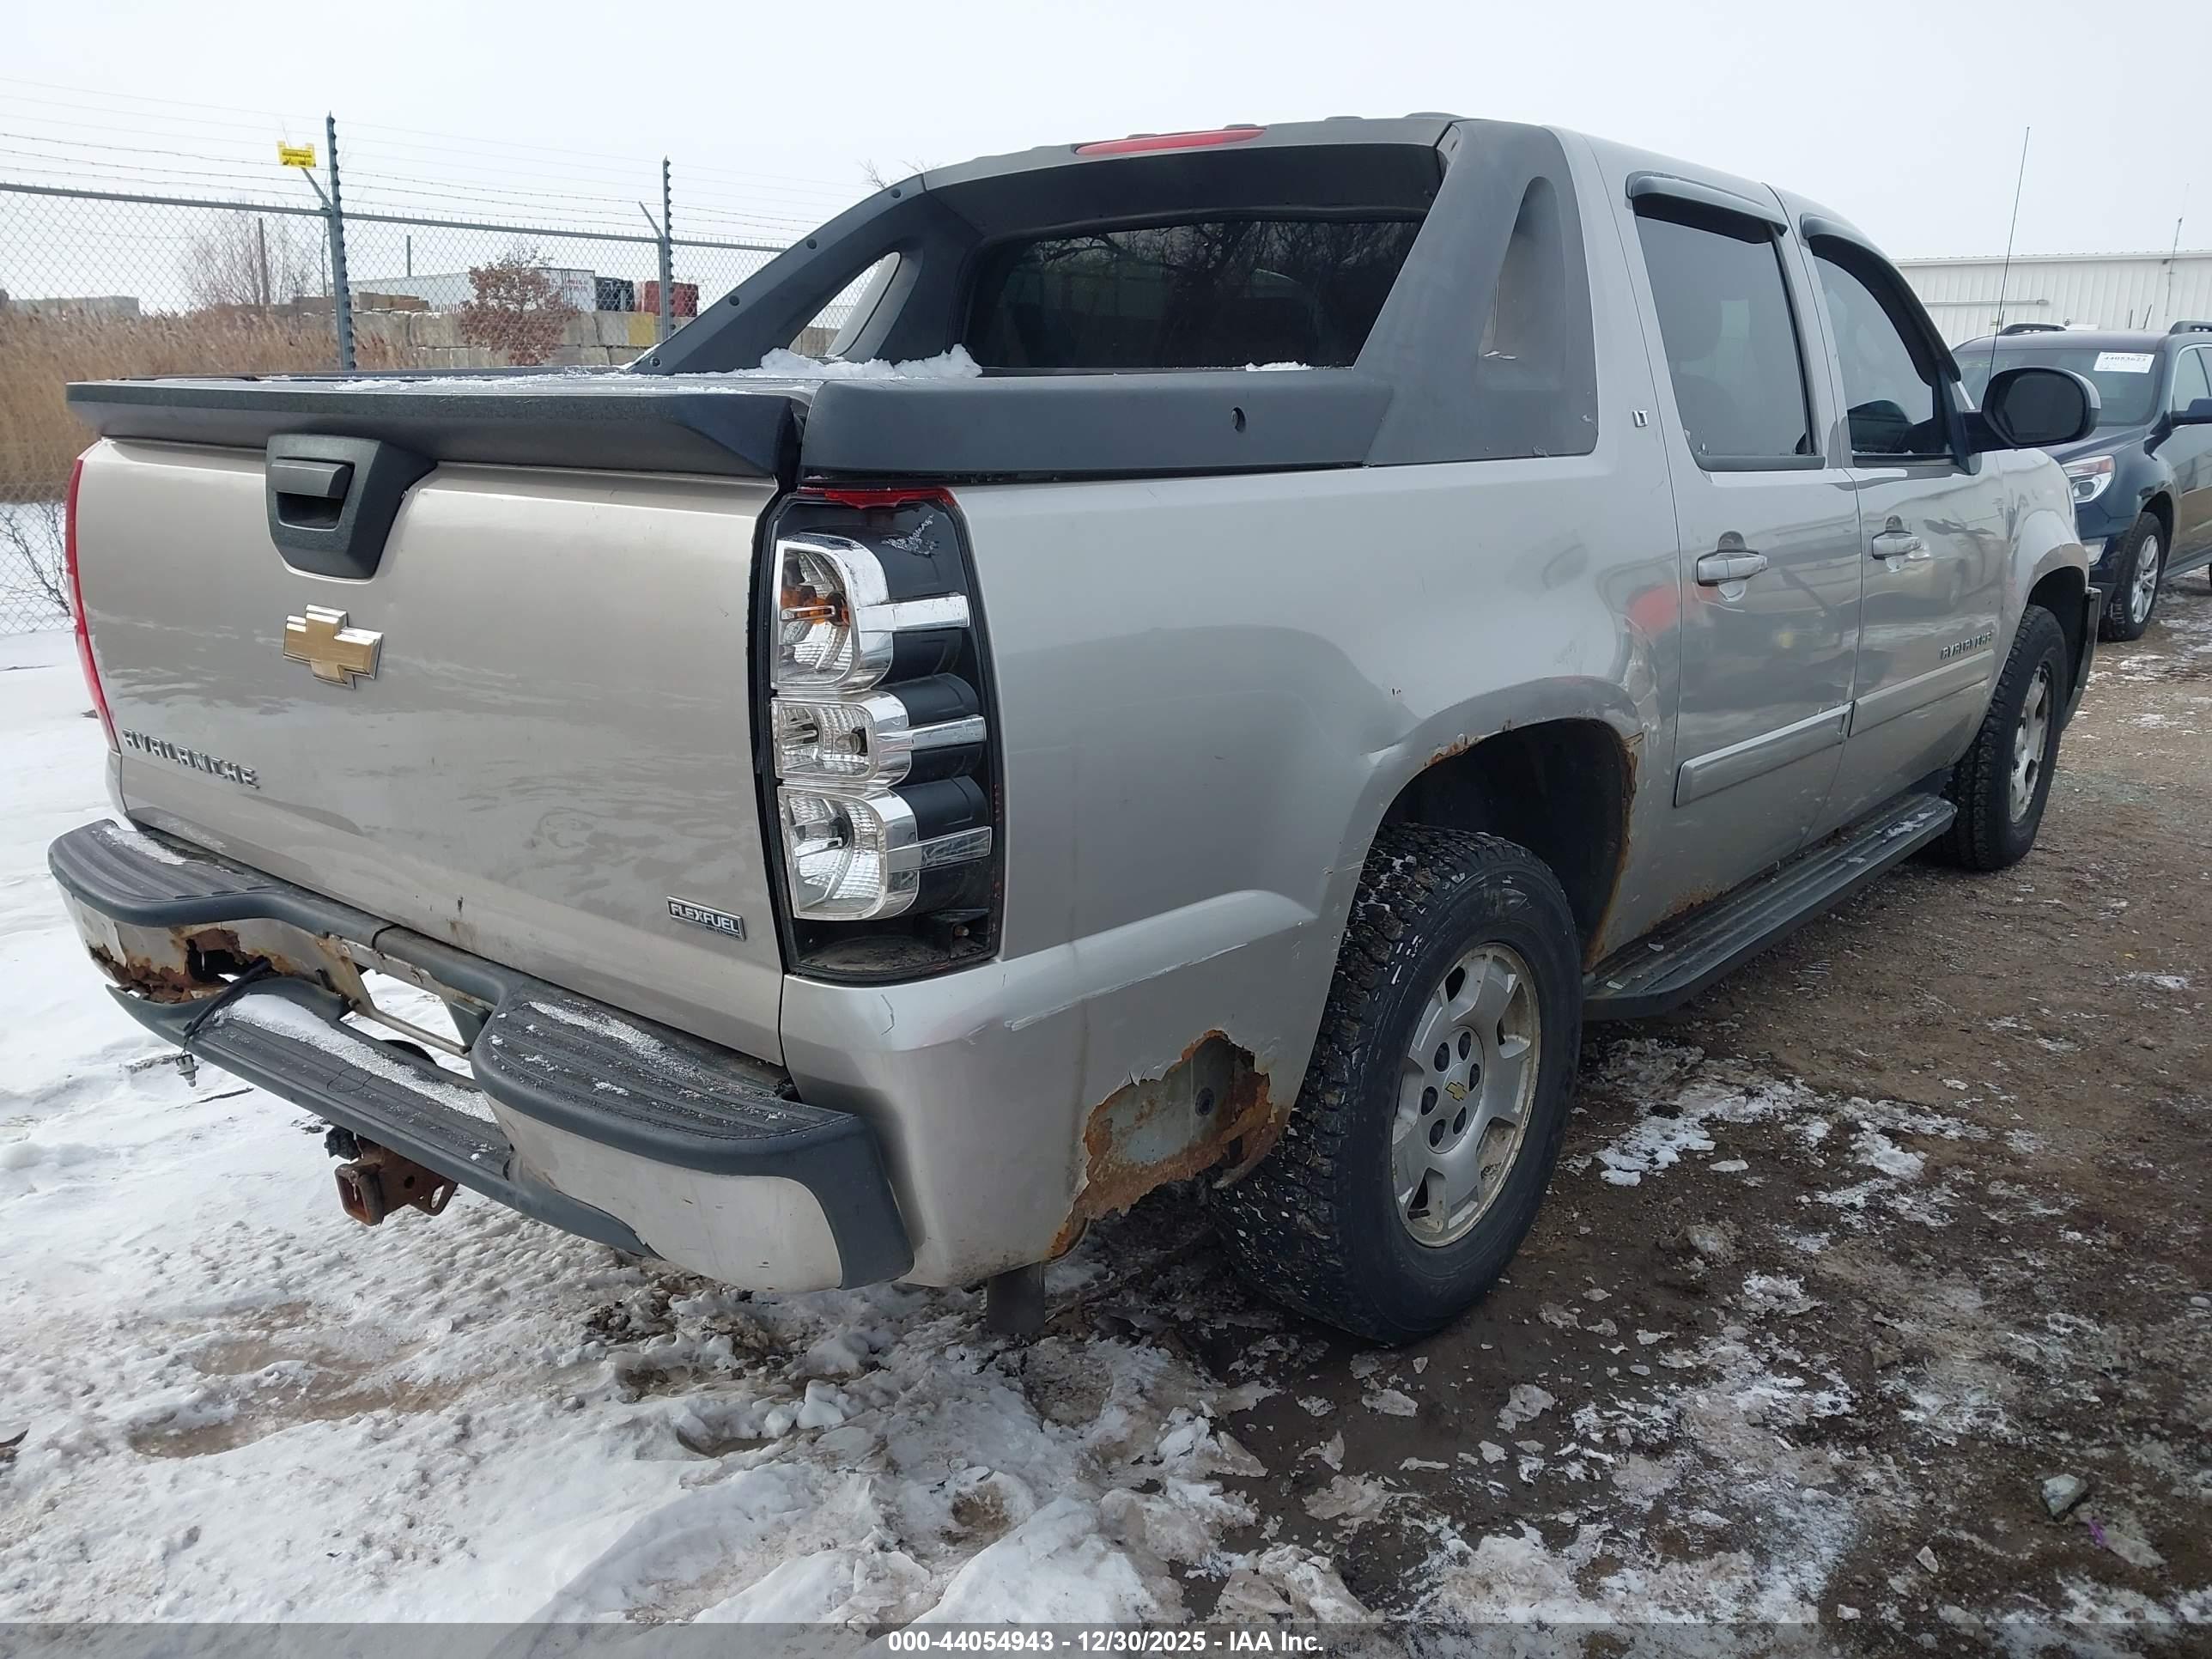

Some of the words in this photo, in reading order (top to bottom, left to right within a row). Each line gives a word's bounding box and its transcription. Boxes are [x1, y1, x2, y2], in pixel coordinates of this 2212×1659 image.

[1632, 410, 1648, 428] LT
[122, 728, 260, 789] AVALANCHE
[670, 902, 738, 933] FLEXFUEL
